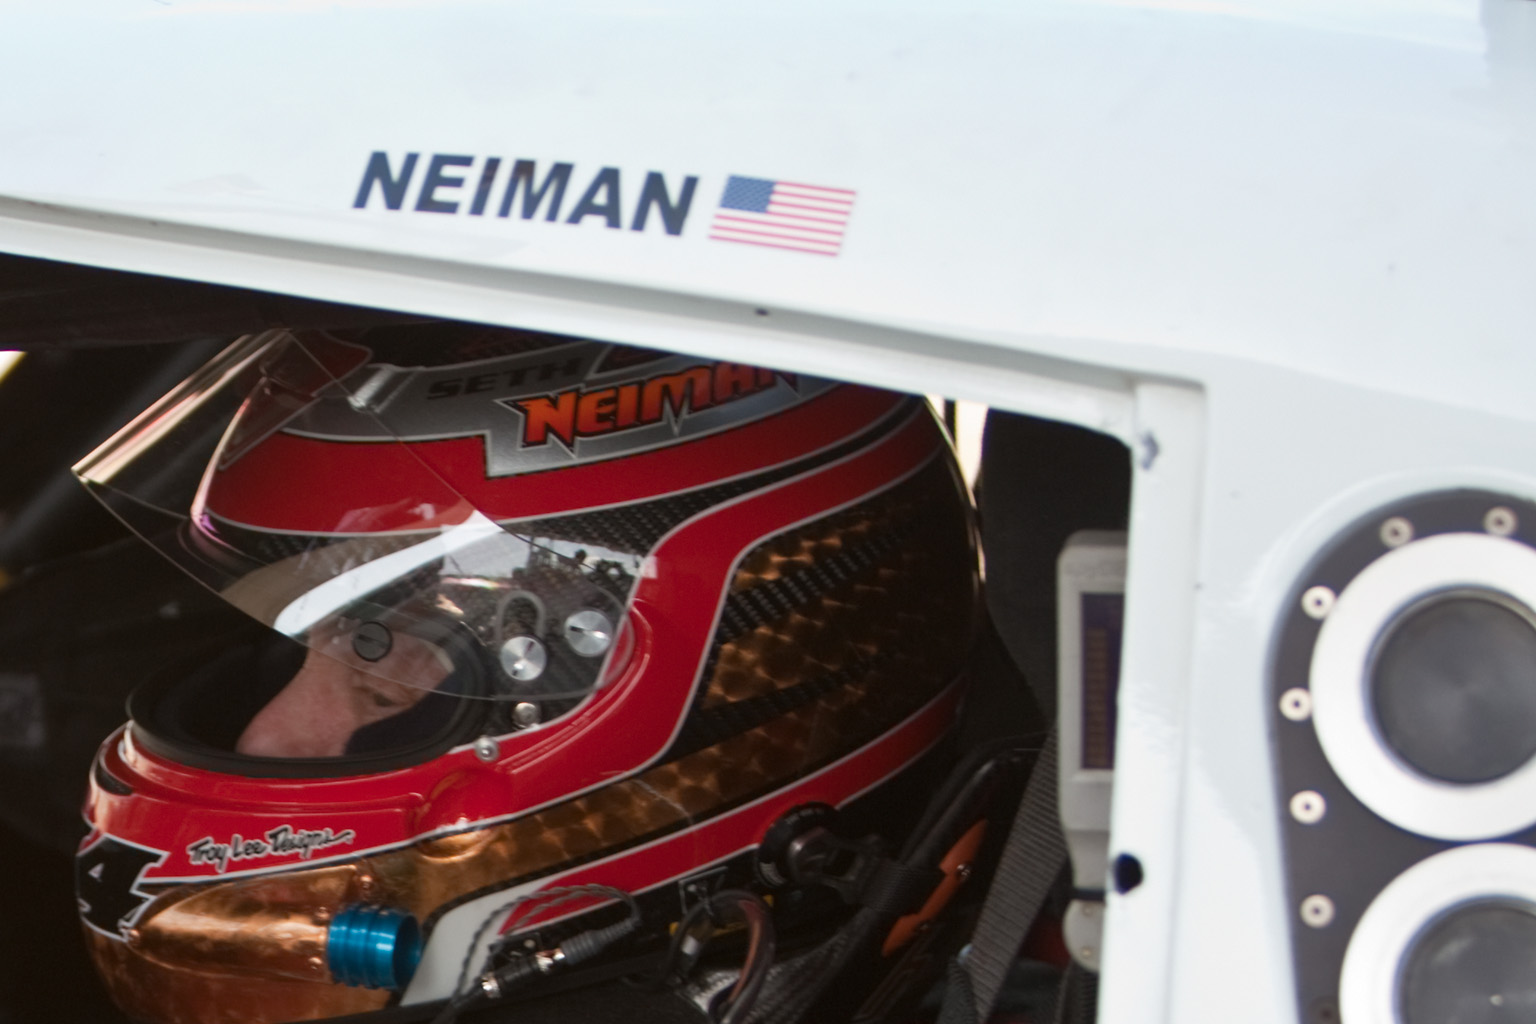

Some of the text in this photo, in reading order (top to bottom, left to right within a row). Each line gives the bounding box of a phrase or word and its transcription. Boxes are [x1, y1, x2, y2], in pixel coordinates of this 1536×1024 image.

[352, 150, 700, 237] NEIMAN
[427, 357, 581, 400] SETH
[187, 824, 356, 874] Troy Lee Designs
